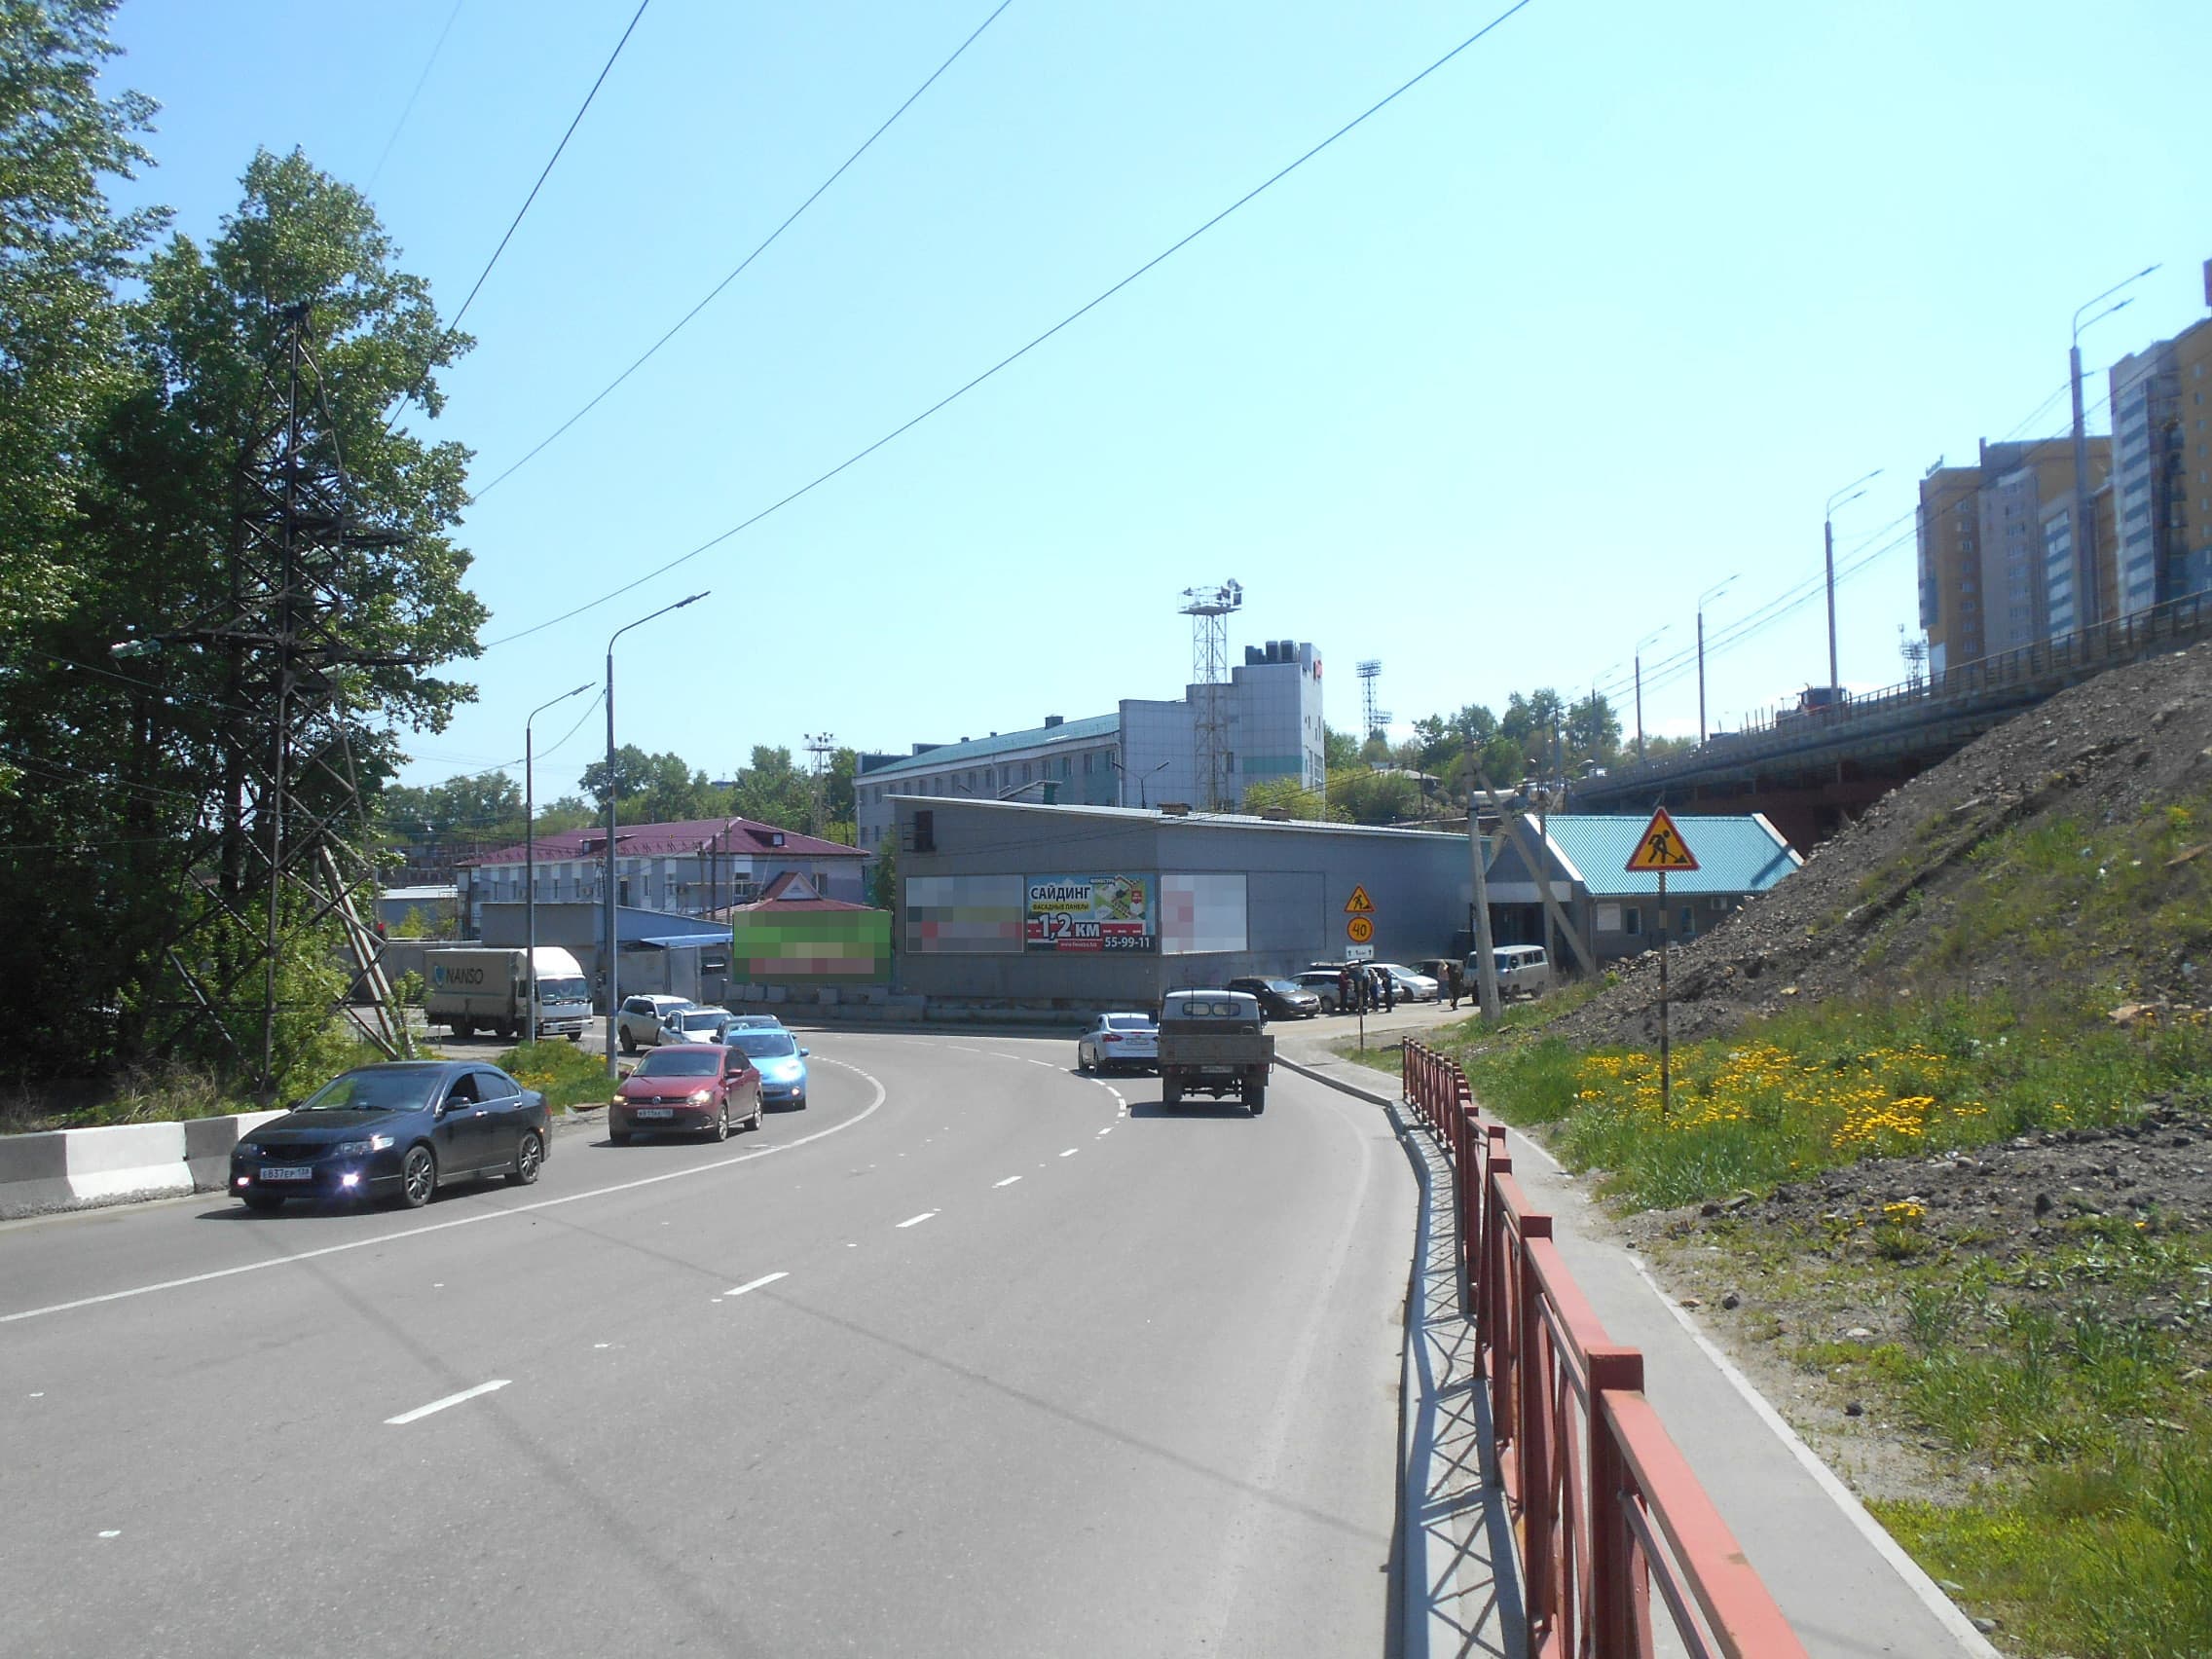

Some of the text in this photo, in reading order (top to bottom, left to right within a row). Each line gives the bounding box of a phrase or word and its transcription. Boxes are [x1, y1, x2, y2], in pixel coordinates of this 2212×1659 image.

[1030, 883, 1090, 902] САЙДИНГ
[1040, 912, 1072, 940] 1,2
[1352, 923, 1367, 937] 40
[1104, 936, 1150, 948] 55-99-11
[446, 968, 484, 984] NANSO
